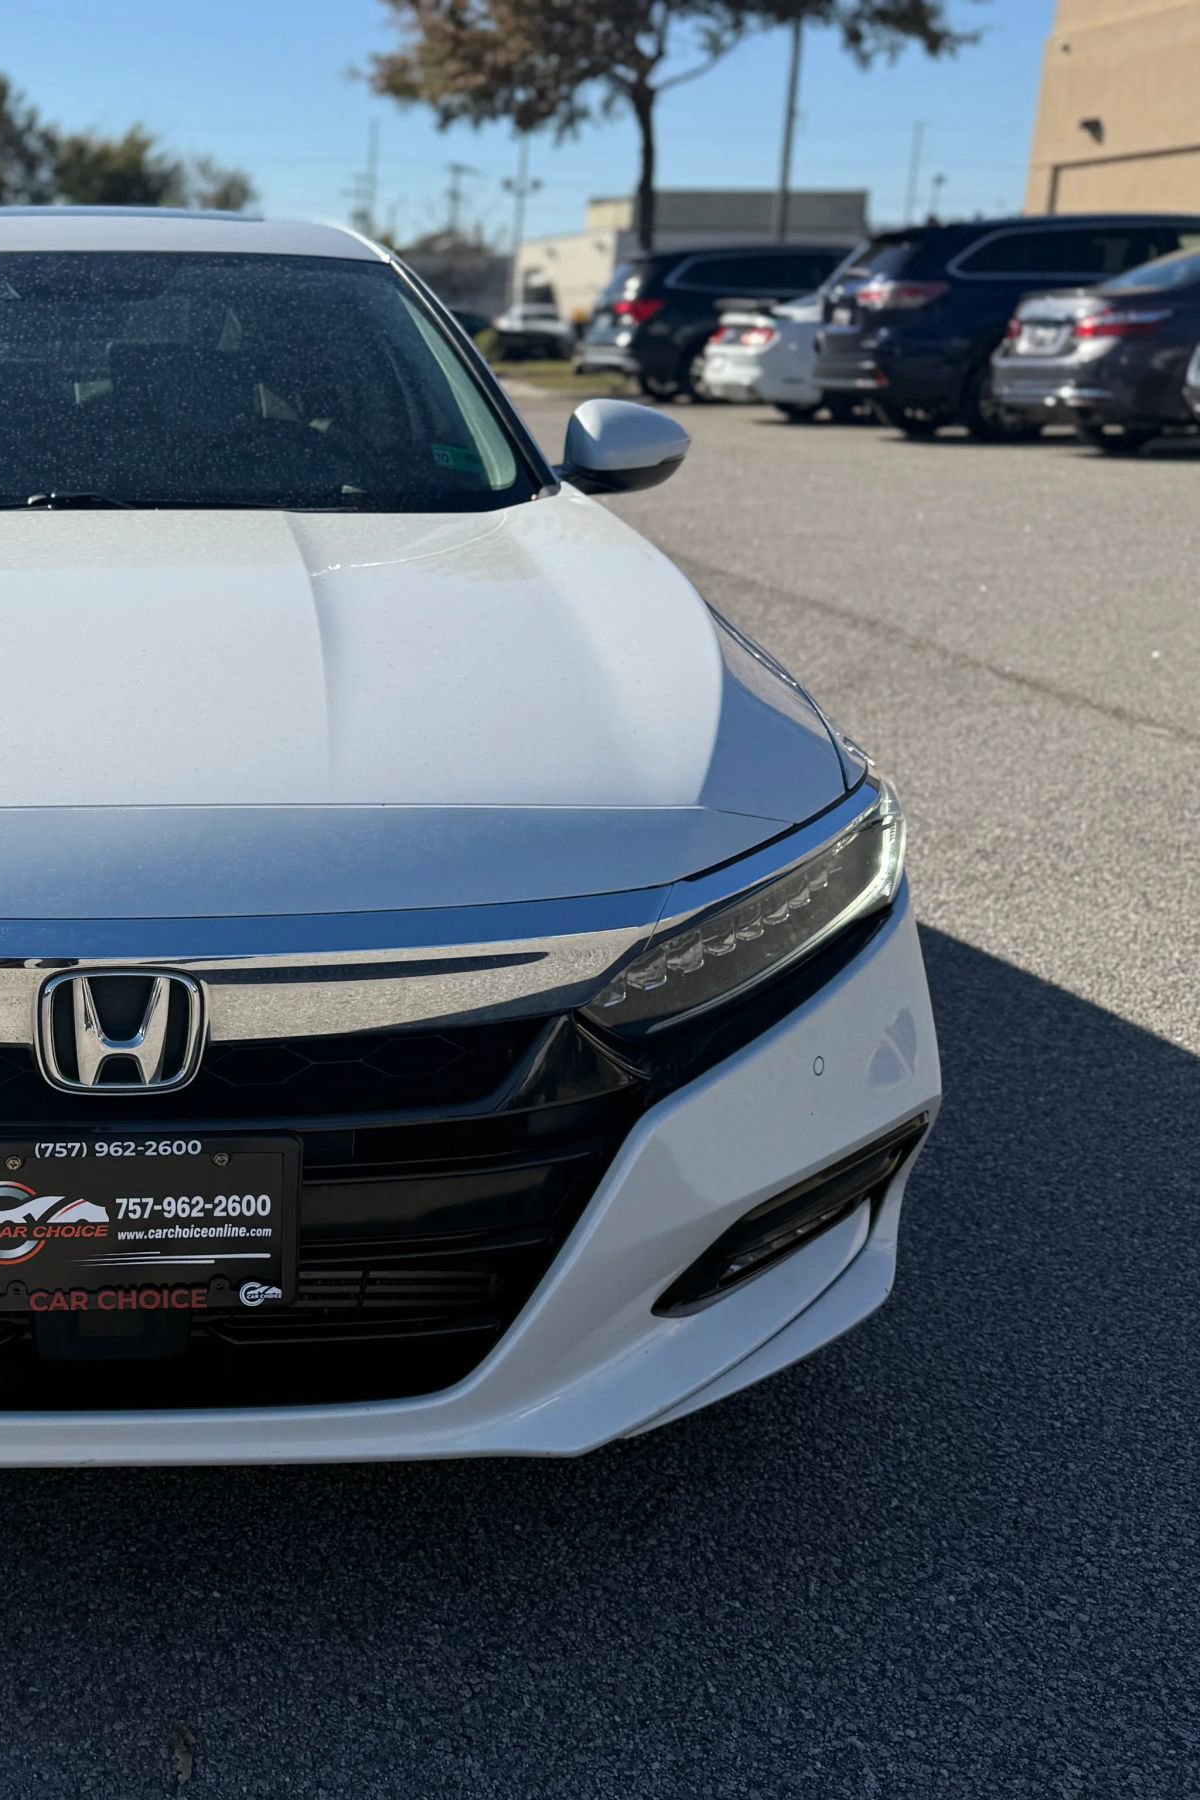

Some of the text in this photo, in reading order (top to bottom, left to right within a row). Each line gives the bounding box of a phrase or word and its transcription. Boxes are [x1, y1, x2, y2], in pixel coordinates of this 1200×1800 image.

[34, 1140, 202, 1158] (757) 962-2600
[115, 1194, 272, 1219] 757-962-2600
[32, 1225, 109, 1238] CHOICE
[117, 1224, 272, 1241] www.carchoiceonline.com
[29, 1288, 208, 1312] CAR CHOICE
